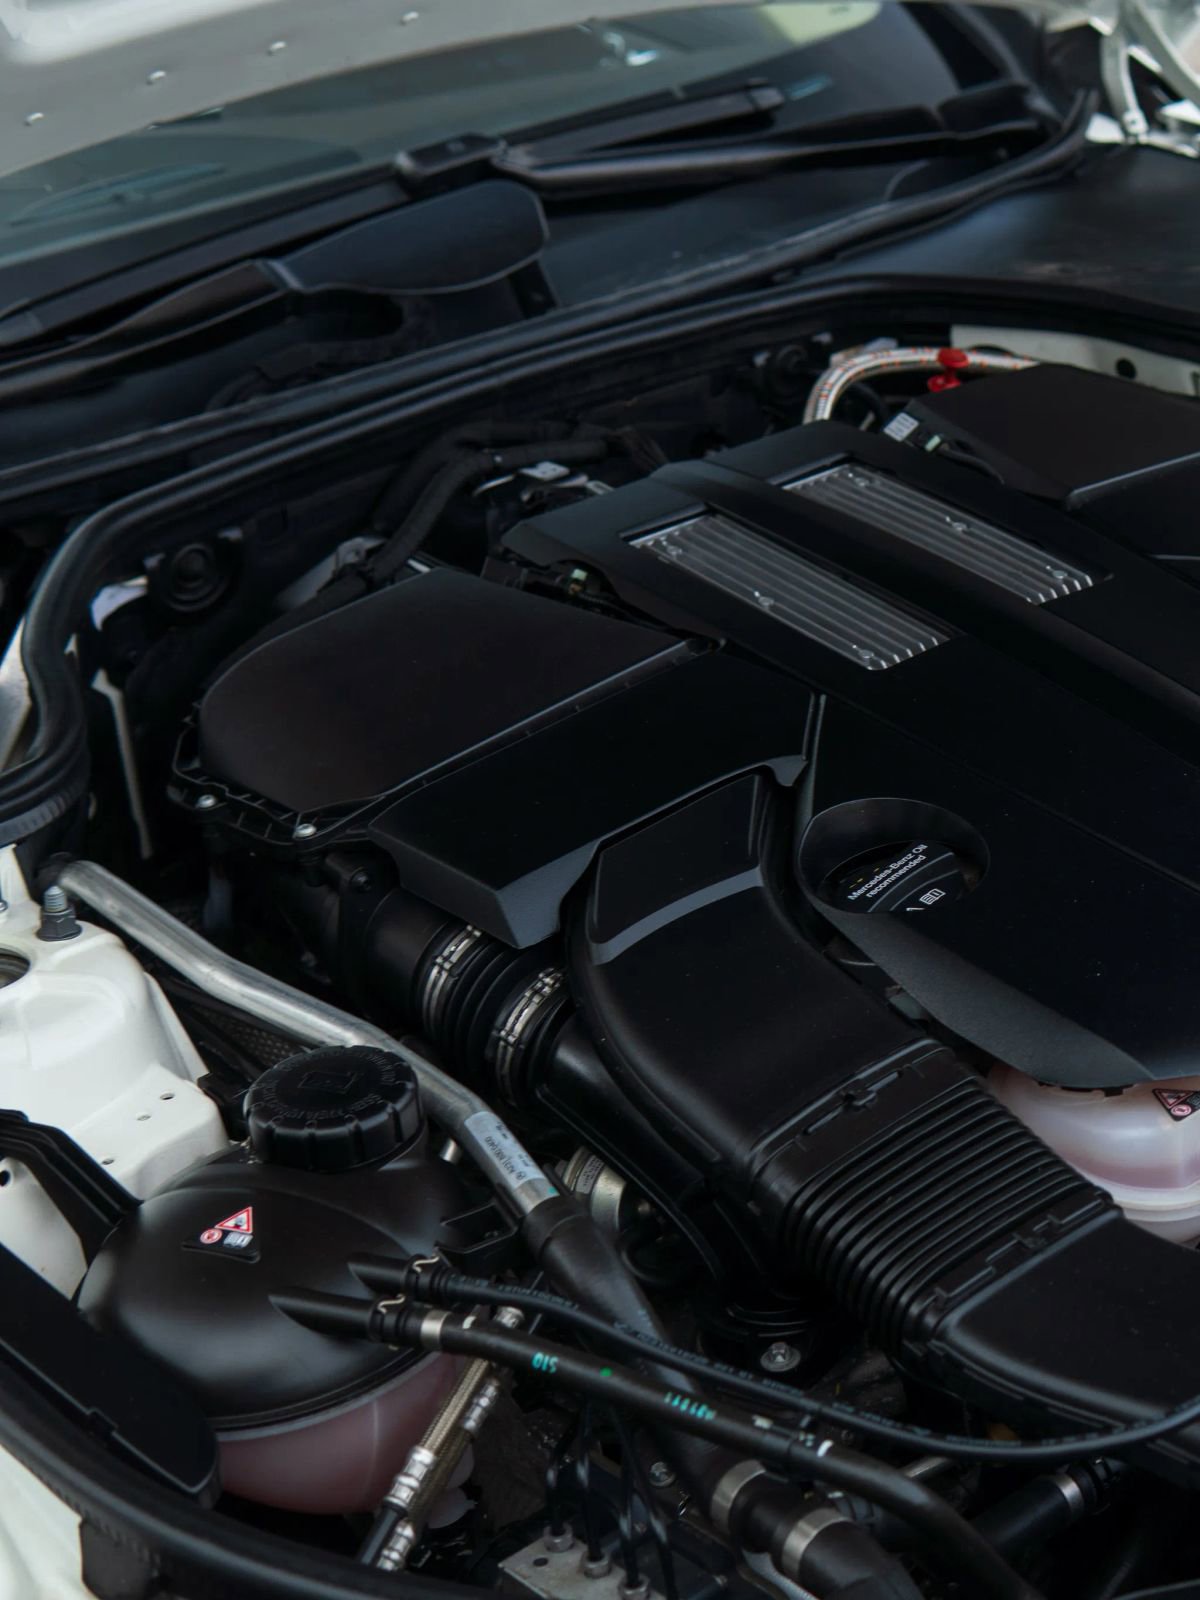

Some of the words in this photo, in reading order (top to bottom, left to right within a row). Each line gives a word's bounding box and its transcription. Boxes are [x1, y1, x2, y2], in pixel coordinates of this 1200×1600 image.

[847, 853, 915, 900] Mercedes-Benz
[912, 844, 928, 854] Oil
[866, 854, 927, 898] recommended
